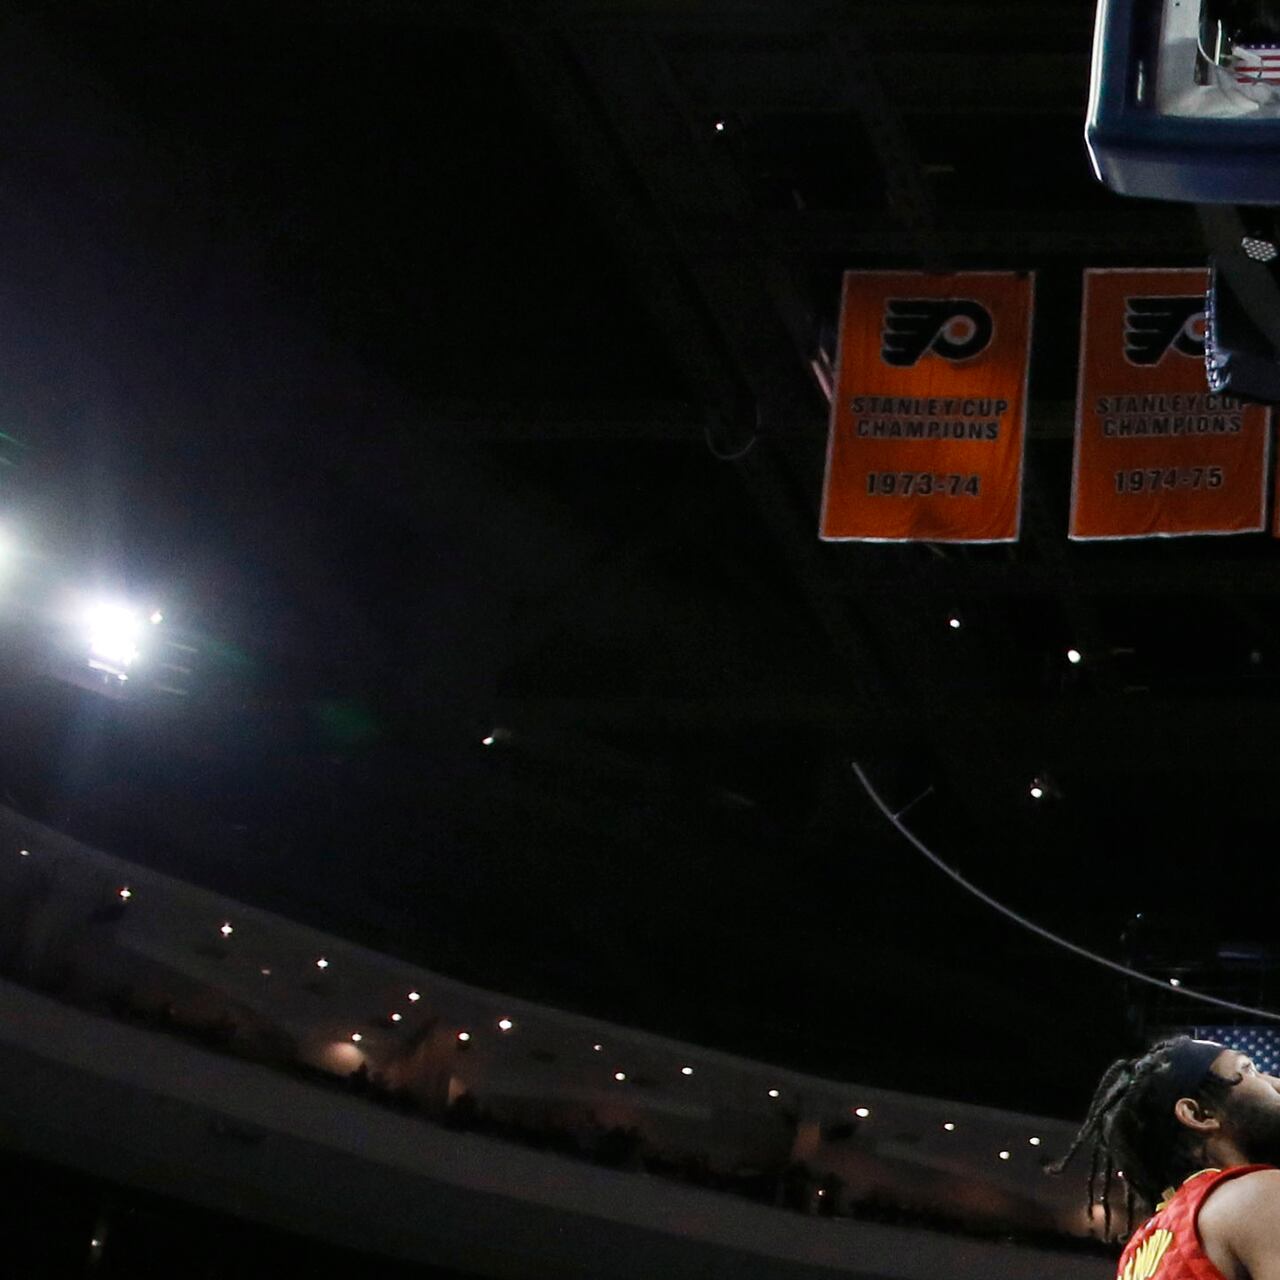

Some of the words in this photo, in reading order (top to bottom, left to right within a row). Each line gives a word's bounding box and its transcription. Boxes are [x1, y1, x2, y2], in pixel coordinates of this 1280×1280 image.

[852, 396, 962, 417] STANLEY
[964, 400, 1009, 419] CUP
[1095, 396, 1202, 415] STANLEY
[856, 418, 999, 440] CHAMPIONS
[1103, 413, 1242, 437] CHAMPIONS
[866, 472, 981, 496] 1973-74
[1113, 468, 1223, 492] 1974-75
